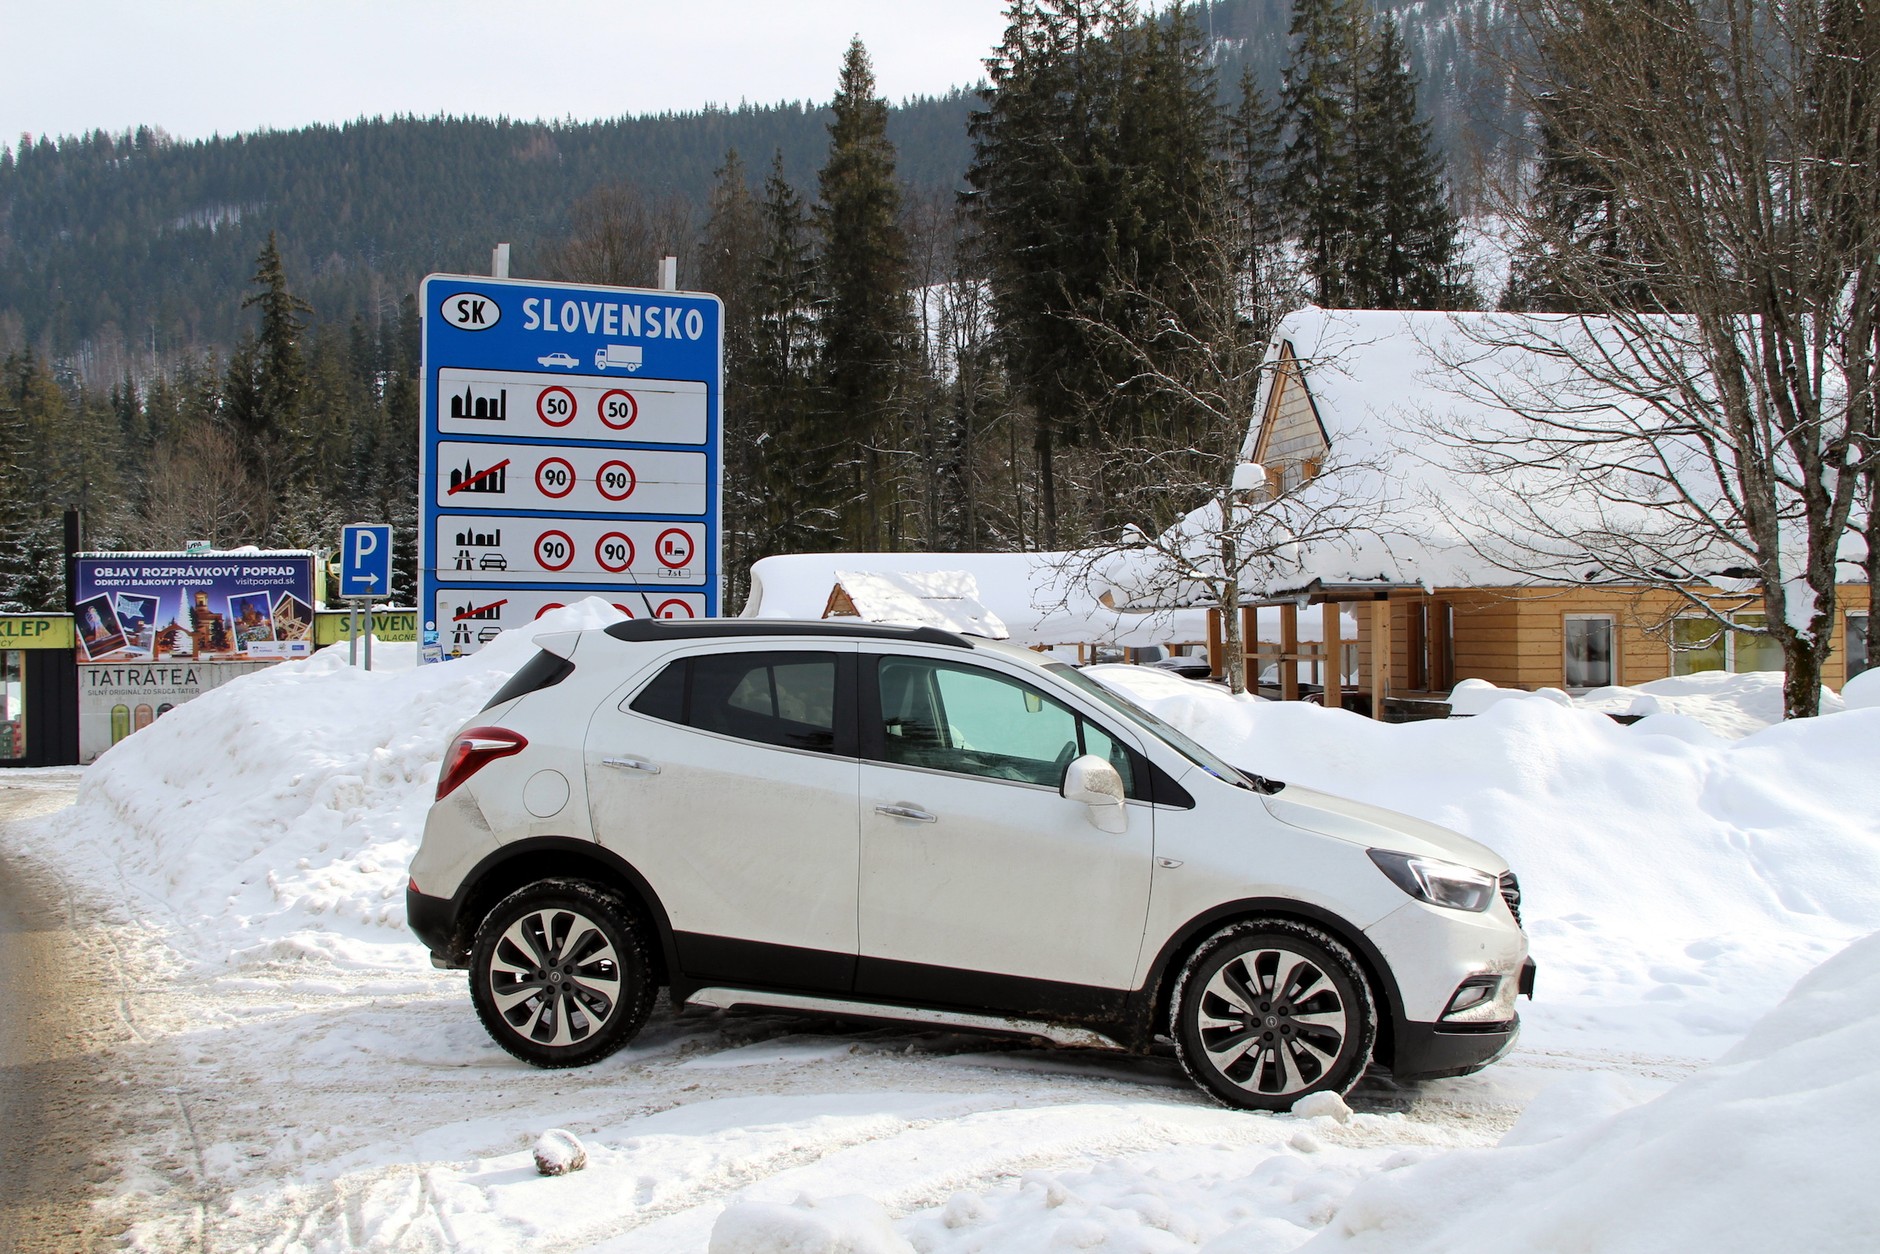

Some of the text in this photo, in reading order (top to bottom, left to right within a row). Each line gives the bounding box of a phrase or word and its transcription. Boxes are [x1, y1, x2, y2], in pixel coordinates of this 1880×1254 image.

[457, 300, 486, 324] SK
[522, 298, 704, 341] SLOVENSKO
[547, 398, 628, 418] 50 50
[545, 469, 627, 489] 90 90
[355, 529, 378, 569] P
[543, 542, 626, 560] 90 90
[94, 564, 295, 577] OBJAV ROZPRÁVKOVÝ POPRAD
[235, 576, 295, 587] visitpoprad.sk
[88, 669, 199, 687] TATRATEA
[143, 687, 152, 695] ZO
[153, 687, 176, 695] SRDCA
[178, 686, 200, 694] TATIER
